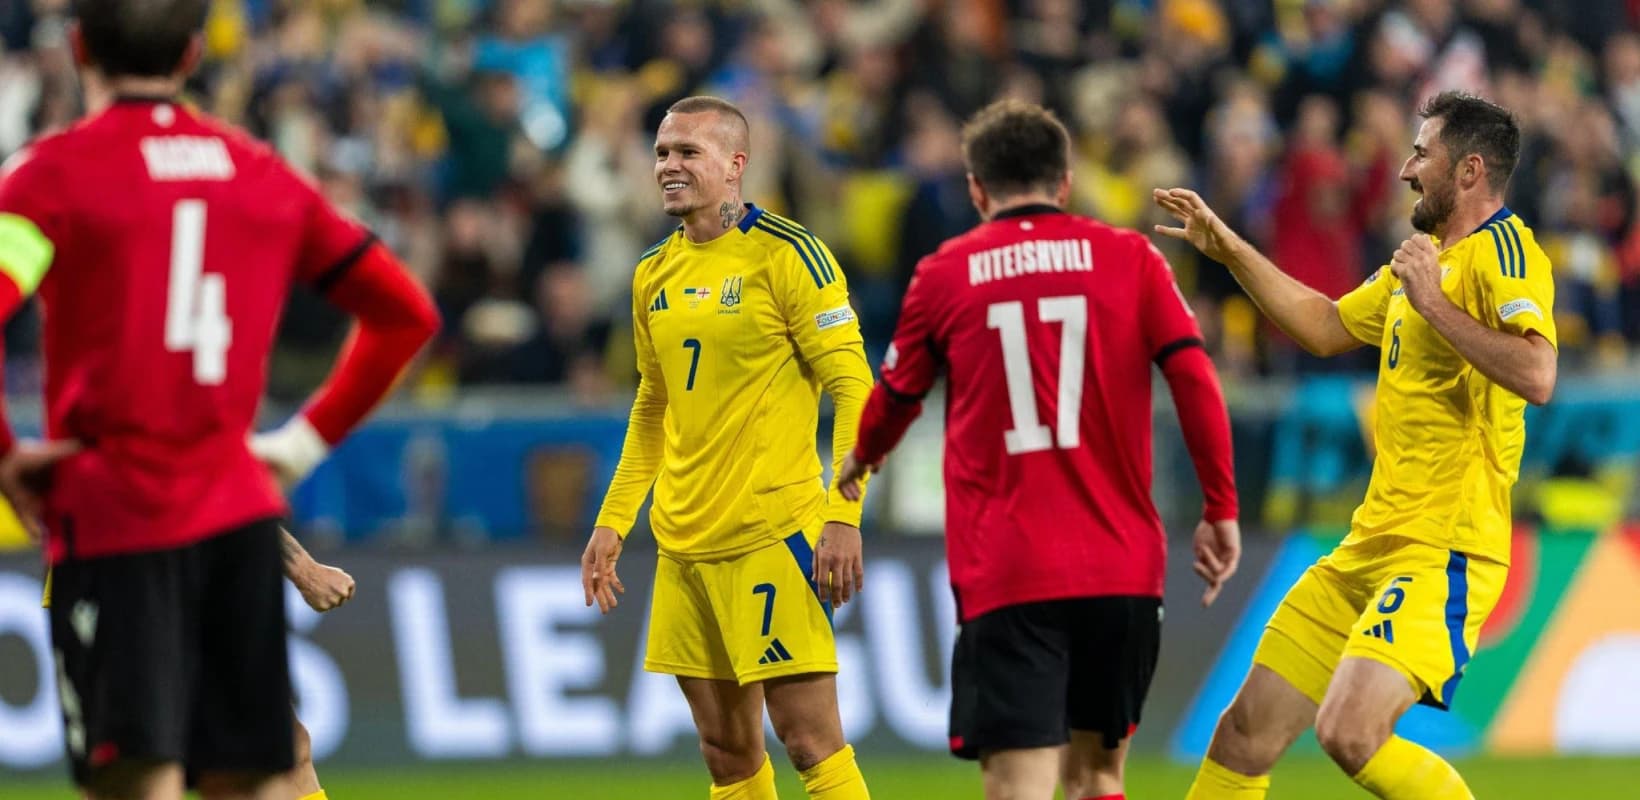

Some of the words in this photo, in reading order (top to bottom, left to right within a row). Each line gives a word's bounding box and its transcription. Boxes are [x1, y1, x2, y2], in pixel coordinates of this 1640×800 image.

[968, 239, 1093, 286] KITEISHVILI
[164, 199, 233, 386] 4
[683, 338, 701, 391] 7
[1388, 319, 1402, 370] 6
[986, 295, 1087, 455] 17
[752, 582, 777, 637] 7
[1377, 576, 1413, 614] 6
